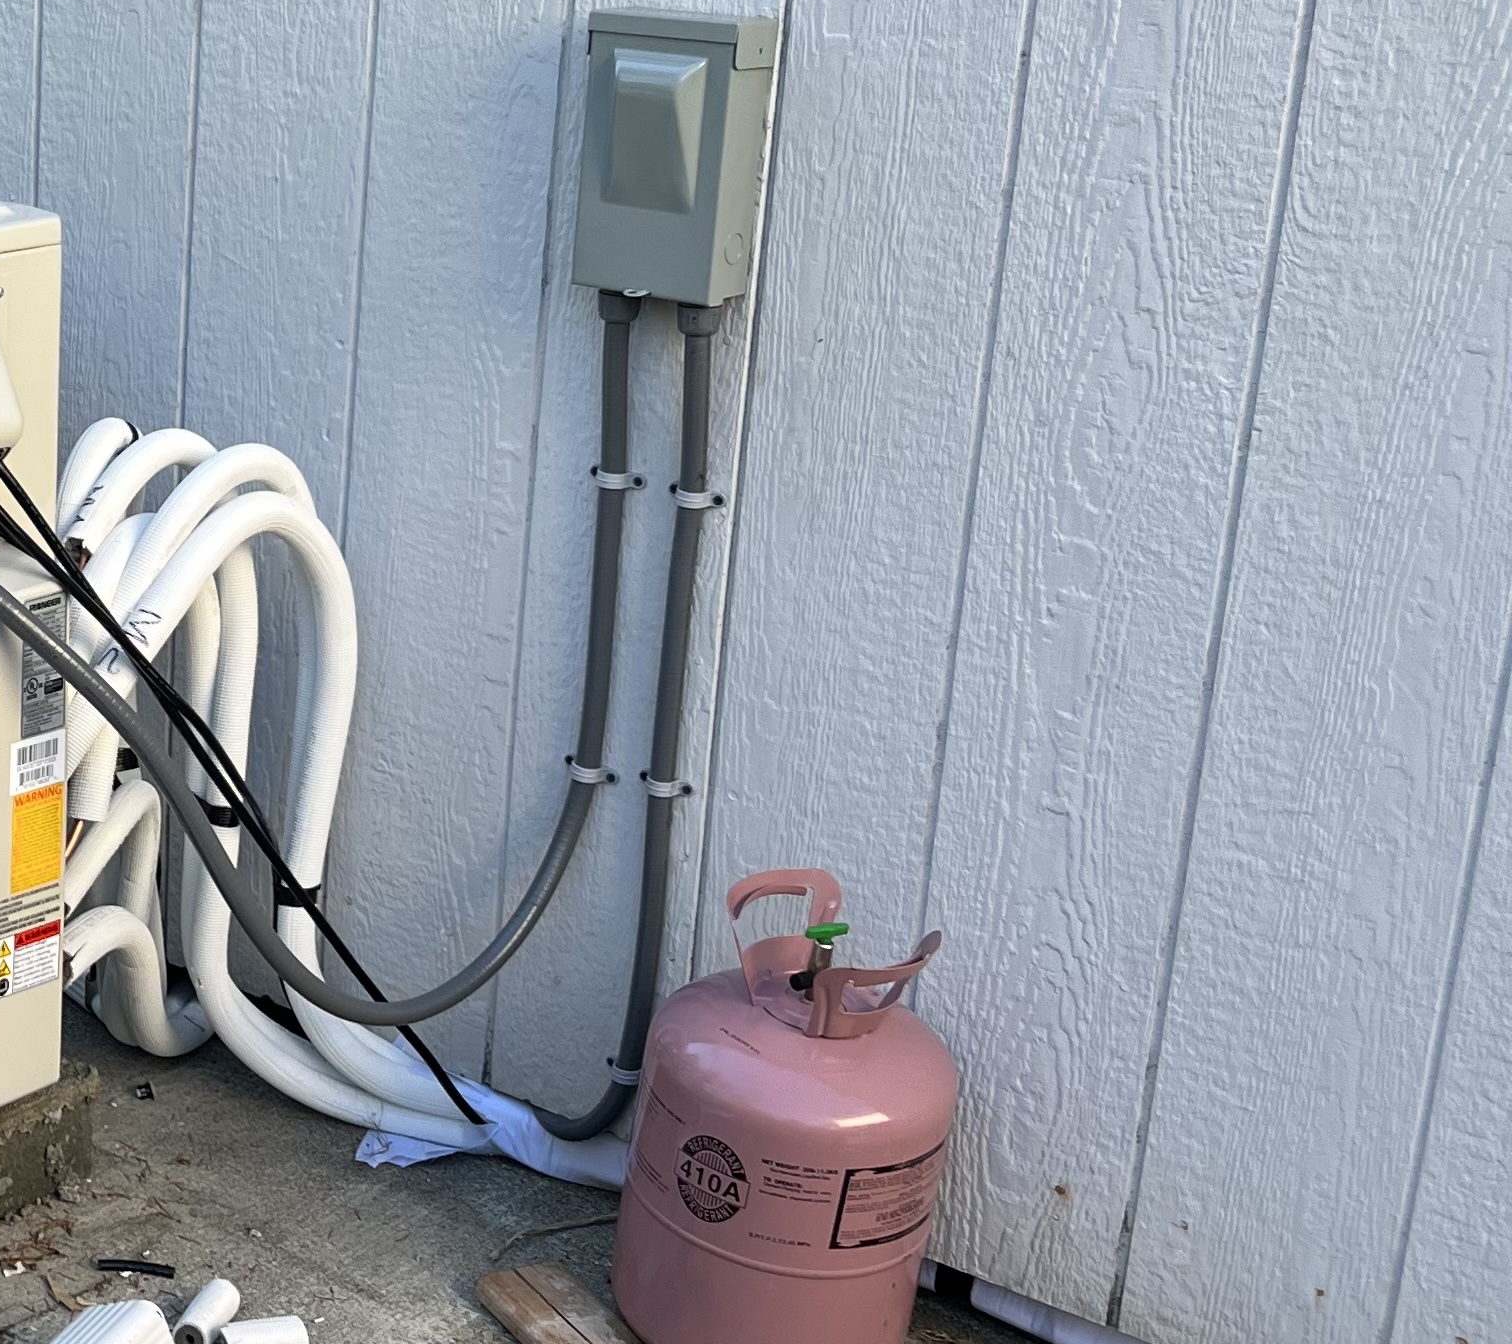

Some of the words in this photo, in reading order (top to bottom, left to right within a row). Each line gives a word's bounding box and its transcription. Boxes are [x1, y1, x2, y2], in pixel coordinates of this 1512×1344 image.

[14, 784, 63, 807] WARNING
[688, 1136, 744, 1174] REFRIGERANT
[679, 1159, 741, 1203] 410A
[679, 1184, 735, 1222] REFRIGERANT
